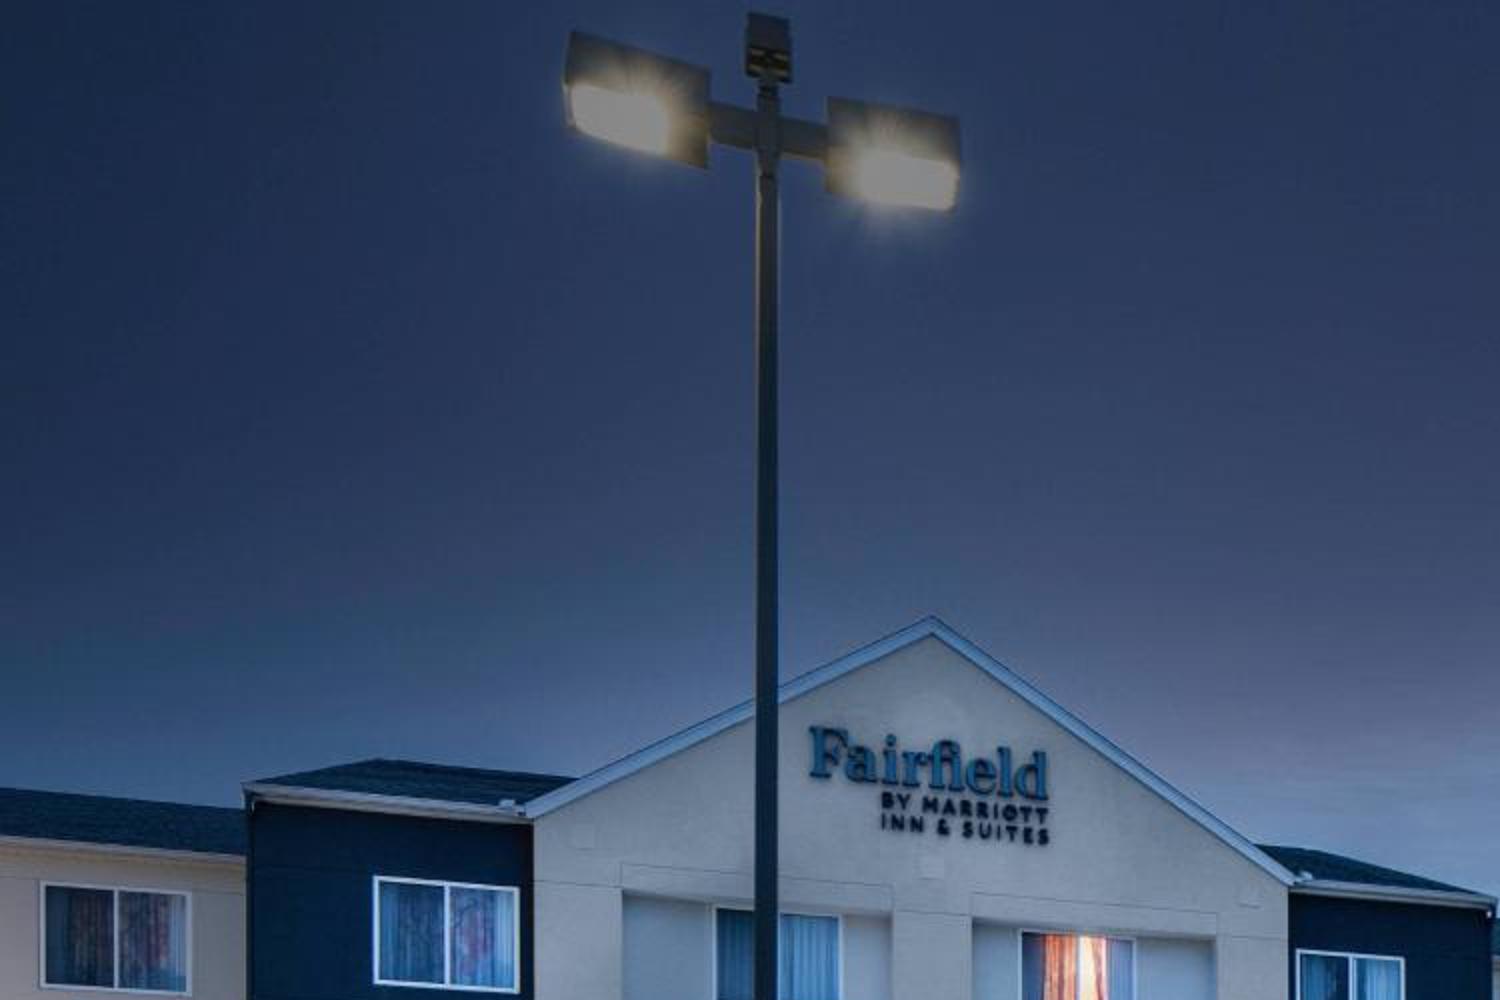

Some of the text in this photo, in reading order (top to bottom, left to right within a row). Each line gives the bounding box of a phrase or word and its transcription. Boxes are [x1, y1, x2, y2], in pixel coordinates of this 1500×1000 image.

[808, 725, 1049, 801] Fairfield
[881, 791, 1049, 825] BY MARRIOTT
[881, 813, 1049, 845] INN & SUITES
